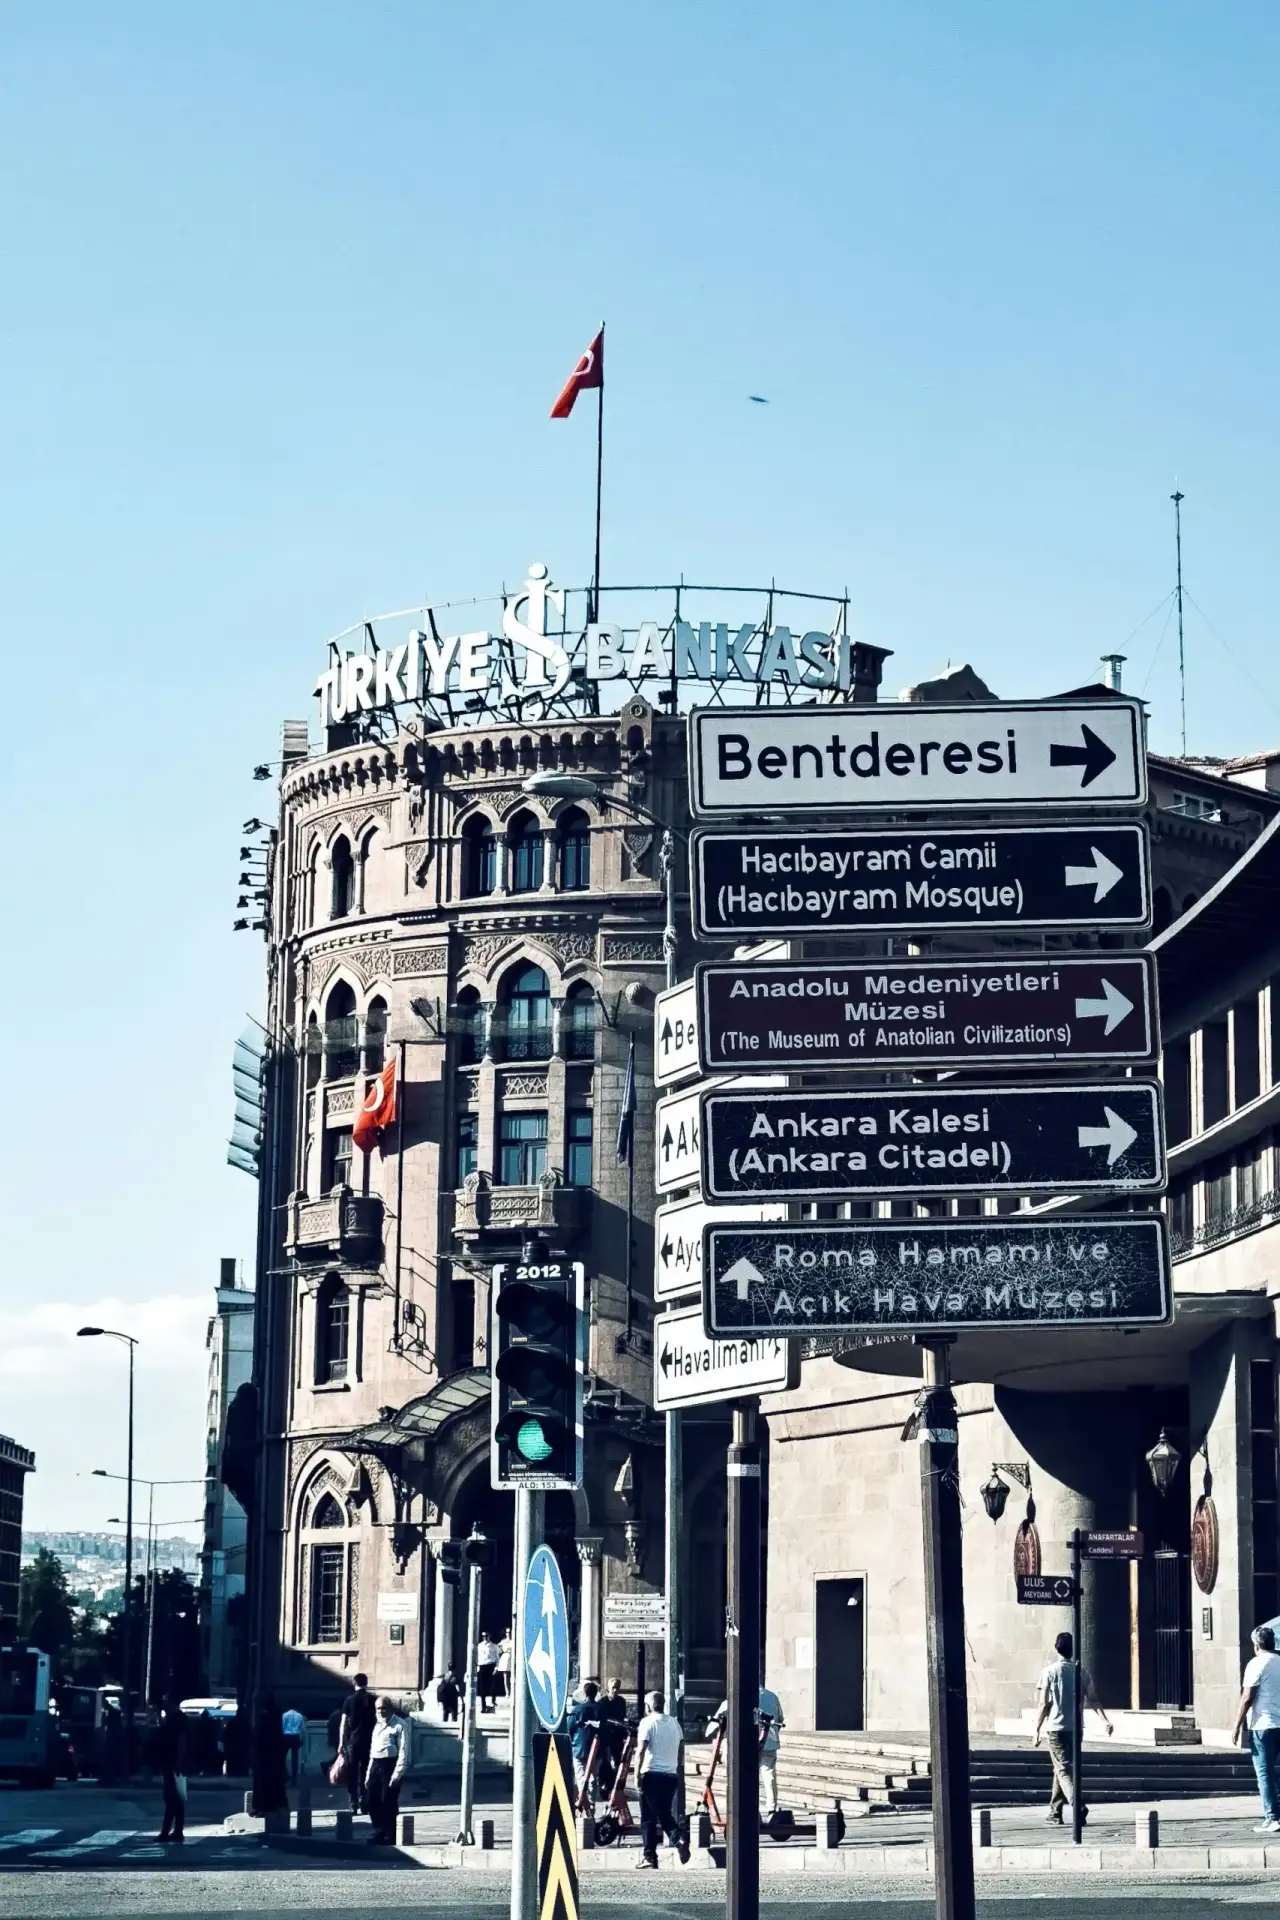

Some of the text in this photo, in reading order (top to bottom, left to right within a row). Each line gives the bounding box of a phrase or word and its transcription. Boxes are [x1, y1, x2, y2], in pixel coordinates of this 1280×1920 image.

[586, 622, 851, 691] BANKASI
[718, 730, 1017, 780] Bentderesi
[741, 842, 998, 879] Hacıbayram Camii
[718, 879, 1024, 921] (Hacıbayram Mosque)
[729, 972, 1060, 998] Anadolu Medeniyetleri
[844, 1001, 945, 1020] Müzesi
[720, 1023, 1072, 1055] (The Museum of Anatolian Civilizations)
[750, 1107, 990, 1137] Ankara Kalesi
[728, 1142, 1012, 1181] (Ankara Citadel)
[775, 1241, 1109, 1267] Roma Hamamı ve
[516, 1265, 561, 1279] 2012
[773, 1289, 850, 1317] Açık
[874, 1288, 963, 1311] Hava
[541, 1481, 557, 1489] 153
[1088, 1533, 1135, 1541] ANAFARTALAR
[1023, 1577, 1045, 1587] ULUS
